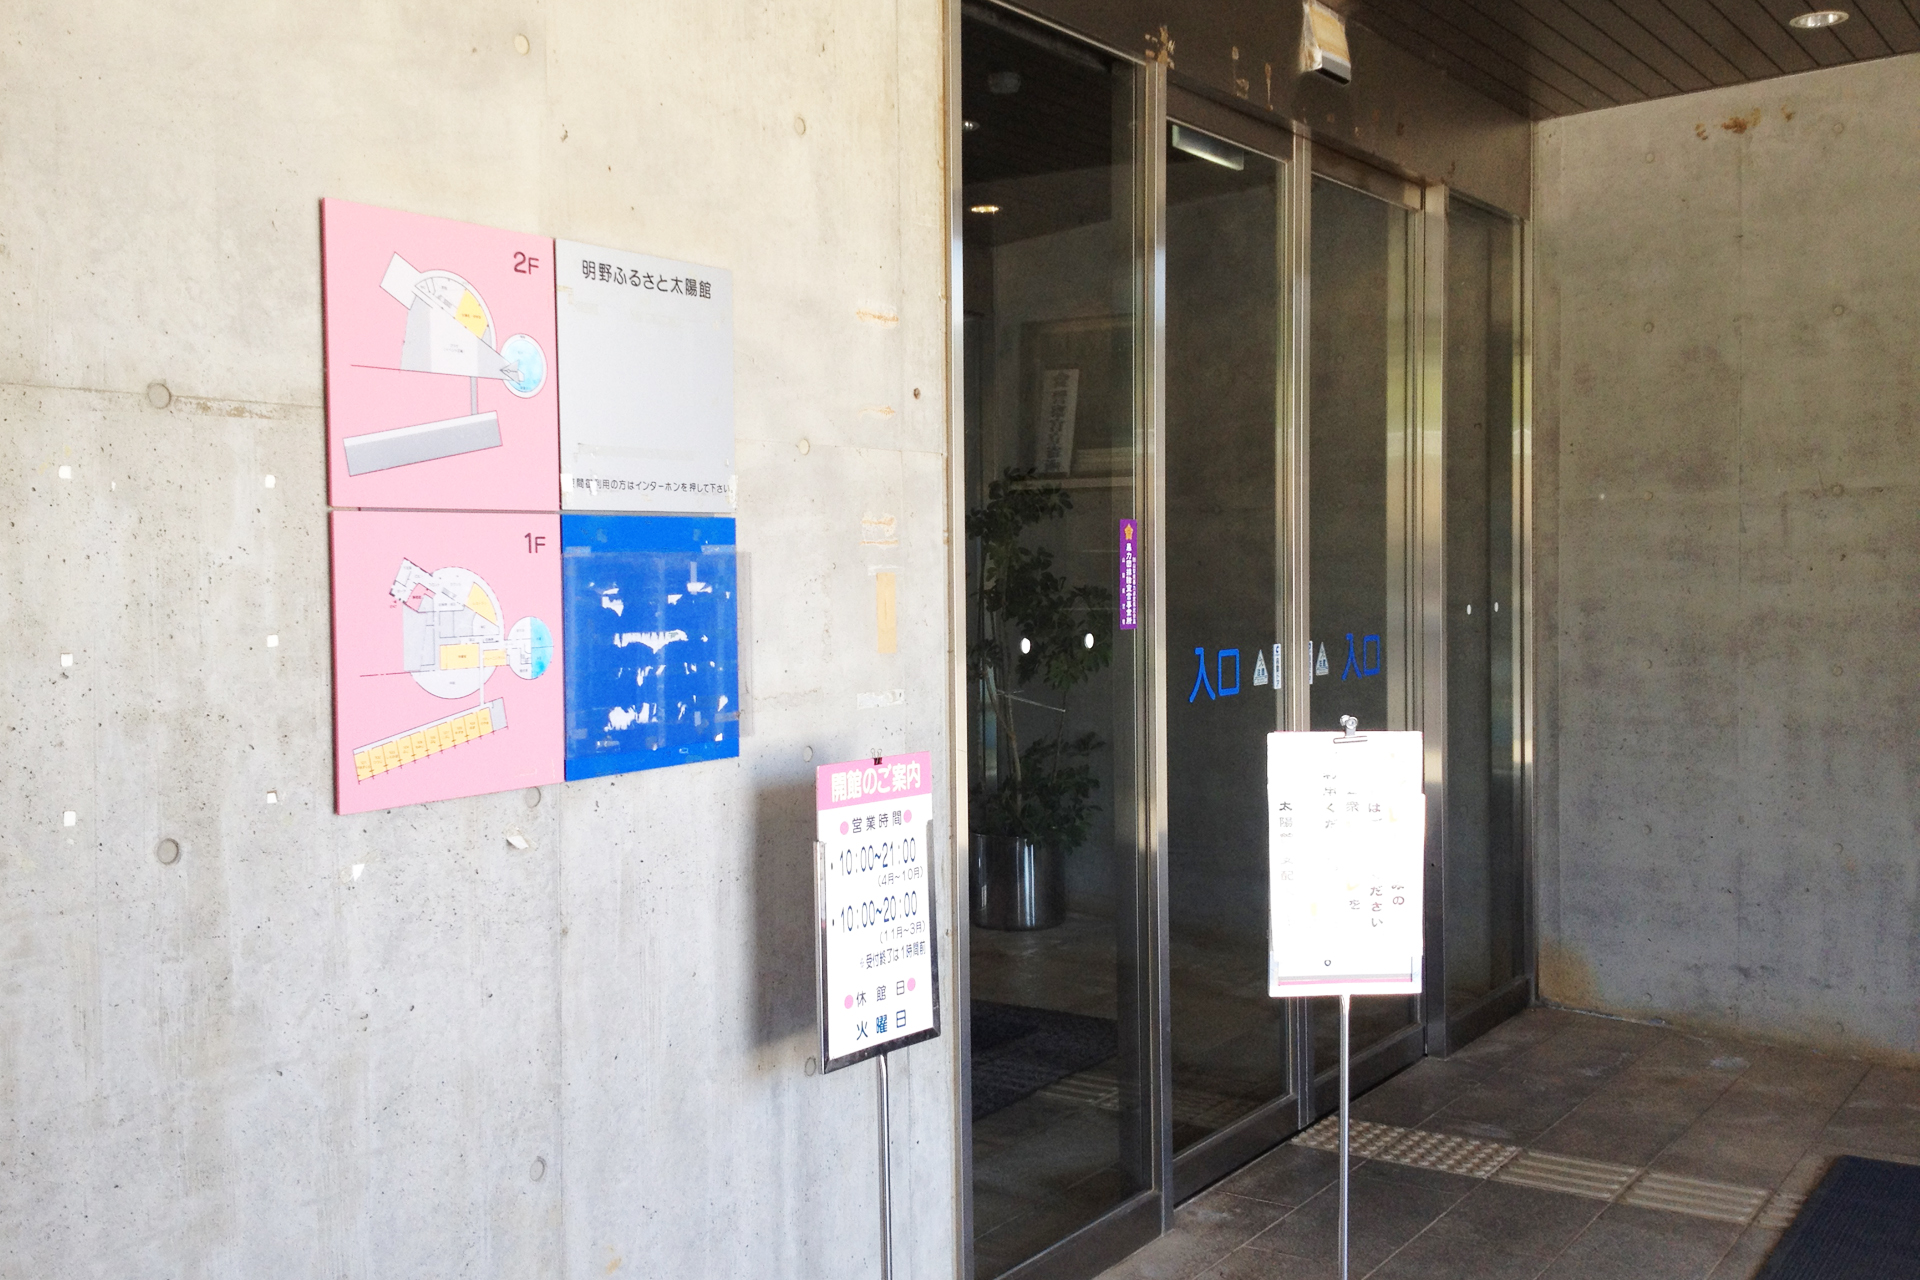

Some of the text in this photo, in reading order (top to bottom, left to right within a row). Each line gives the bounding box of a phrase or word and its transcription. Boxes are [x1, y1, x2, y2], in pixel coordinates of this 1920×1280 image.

[513, 251, 540, 275] 2F
[581, 259, 712, 300] 明野ふるさと太陽館
[572, 477, 733, 494] 間御利用の方はインターホンを押して下さい。
[524, 532, 547, 554] 1F
[1341, 632, 1381, 682] 入口
[1188, 646, 1241, 704] 入口
[831, 760, 921, 803] 開館のご案内
[852, 810, 902, 834] 営業時間
[855, 980, 905, 1007] 休館日
[856, 1009, 907, 1041] 火曜日
